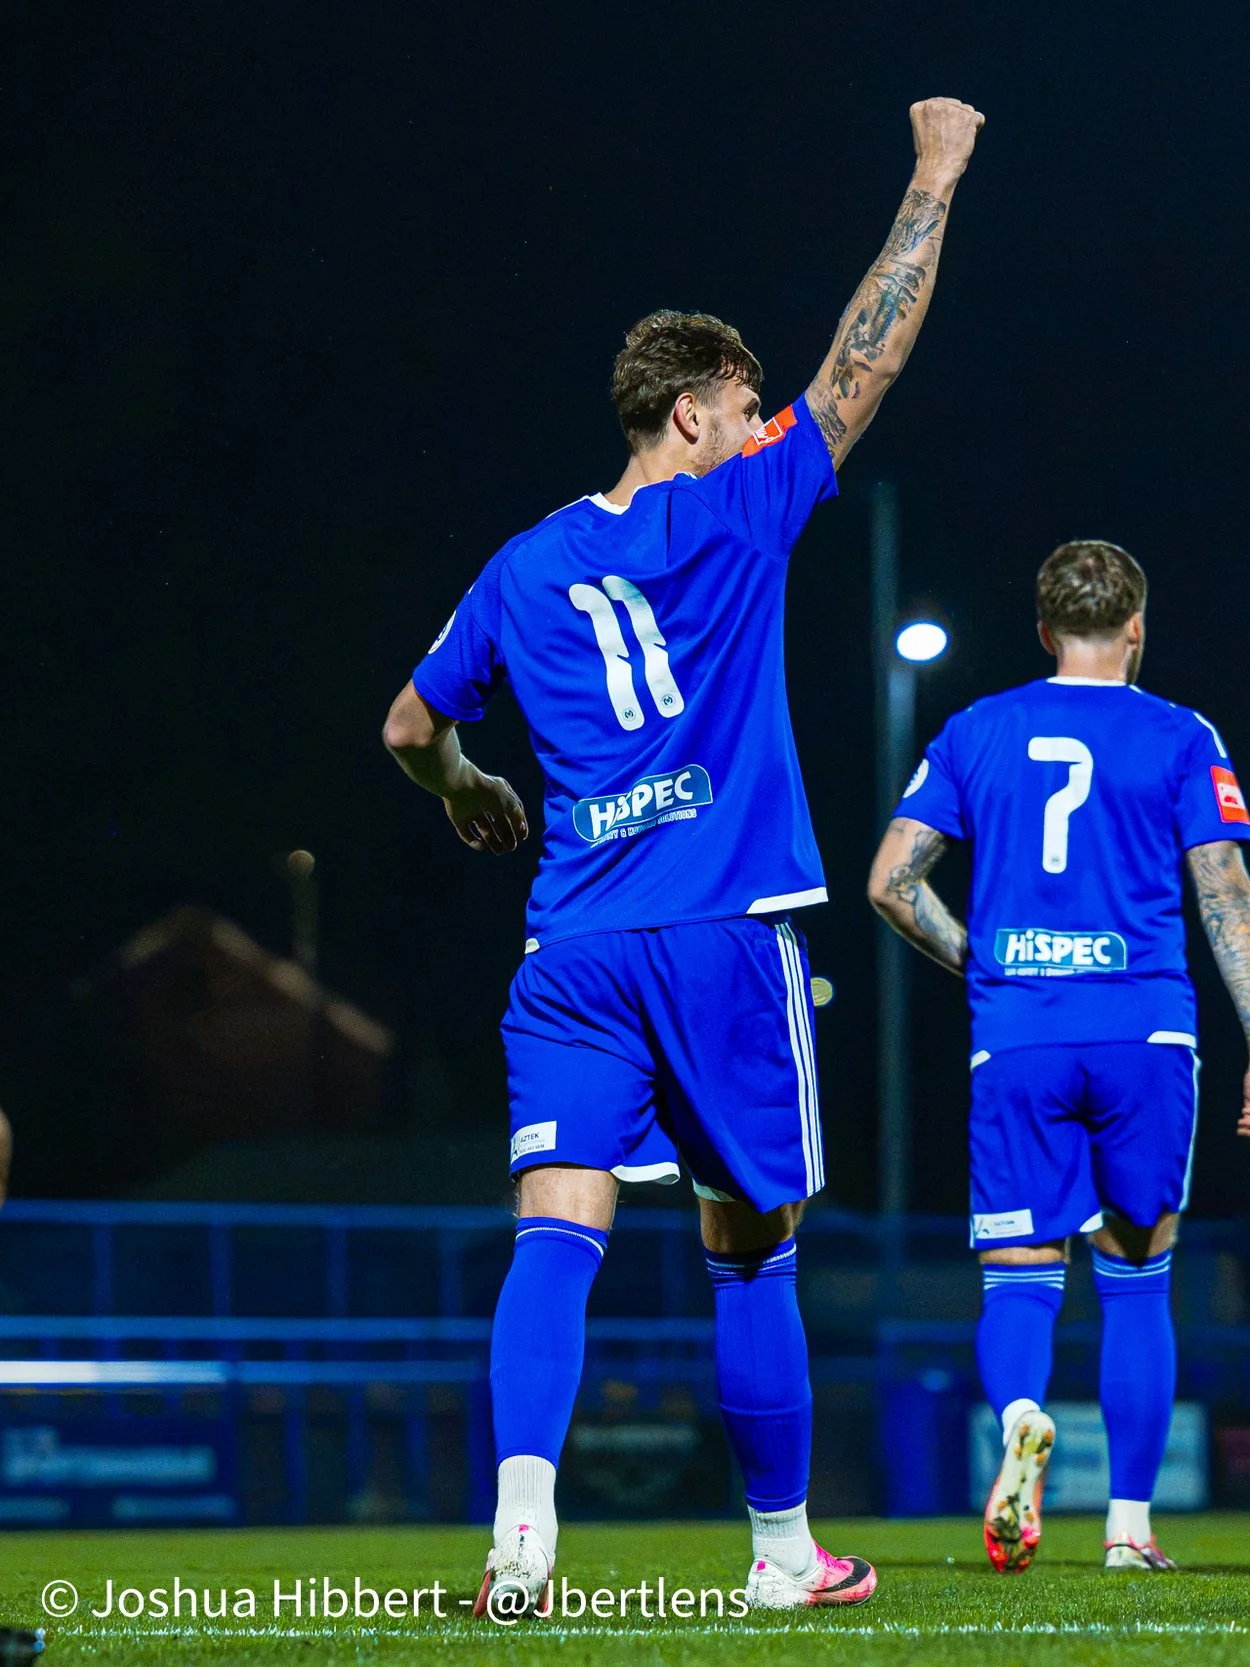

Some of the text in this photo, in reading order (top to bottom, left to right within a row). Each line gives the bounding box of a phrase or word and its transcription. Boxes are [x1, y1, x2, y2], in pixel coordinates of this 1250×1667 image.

[568, 575, 685, 731] 11
[1028, 737, 1093, 873] 7
[1006, 930, 1111, 965] HiSPEC
